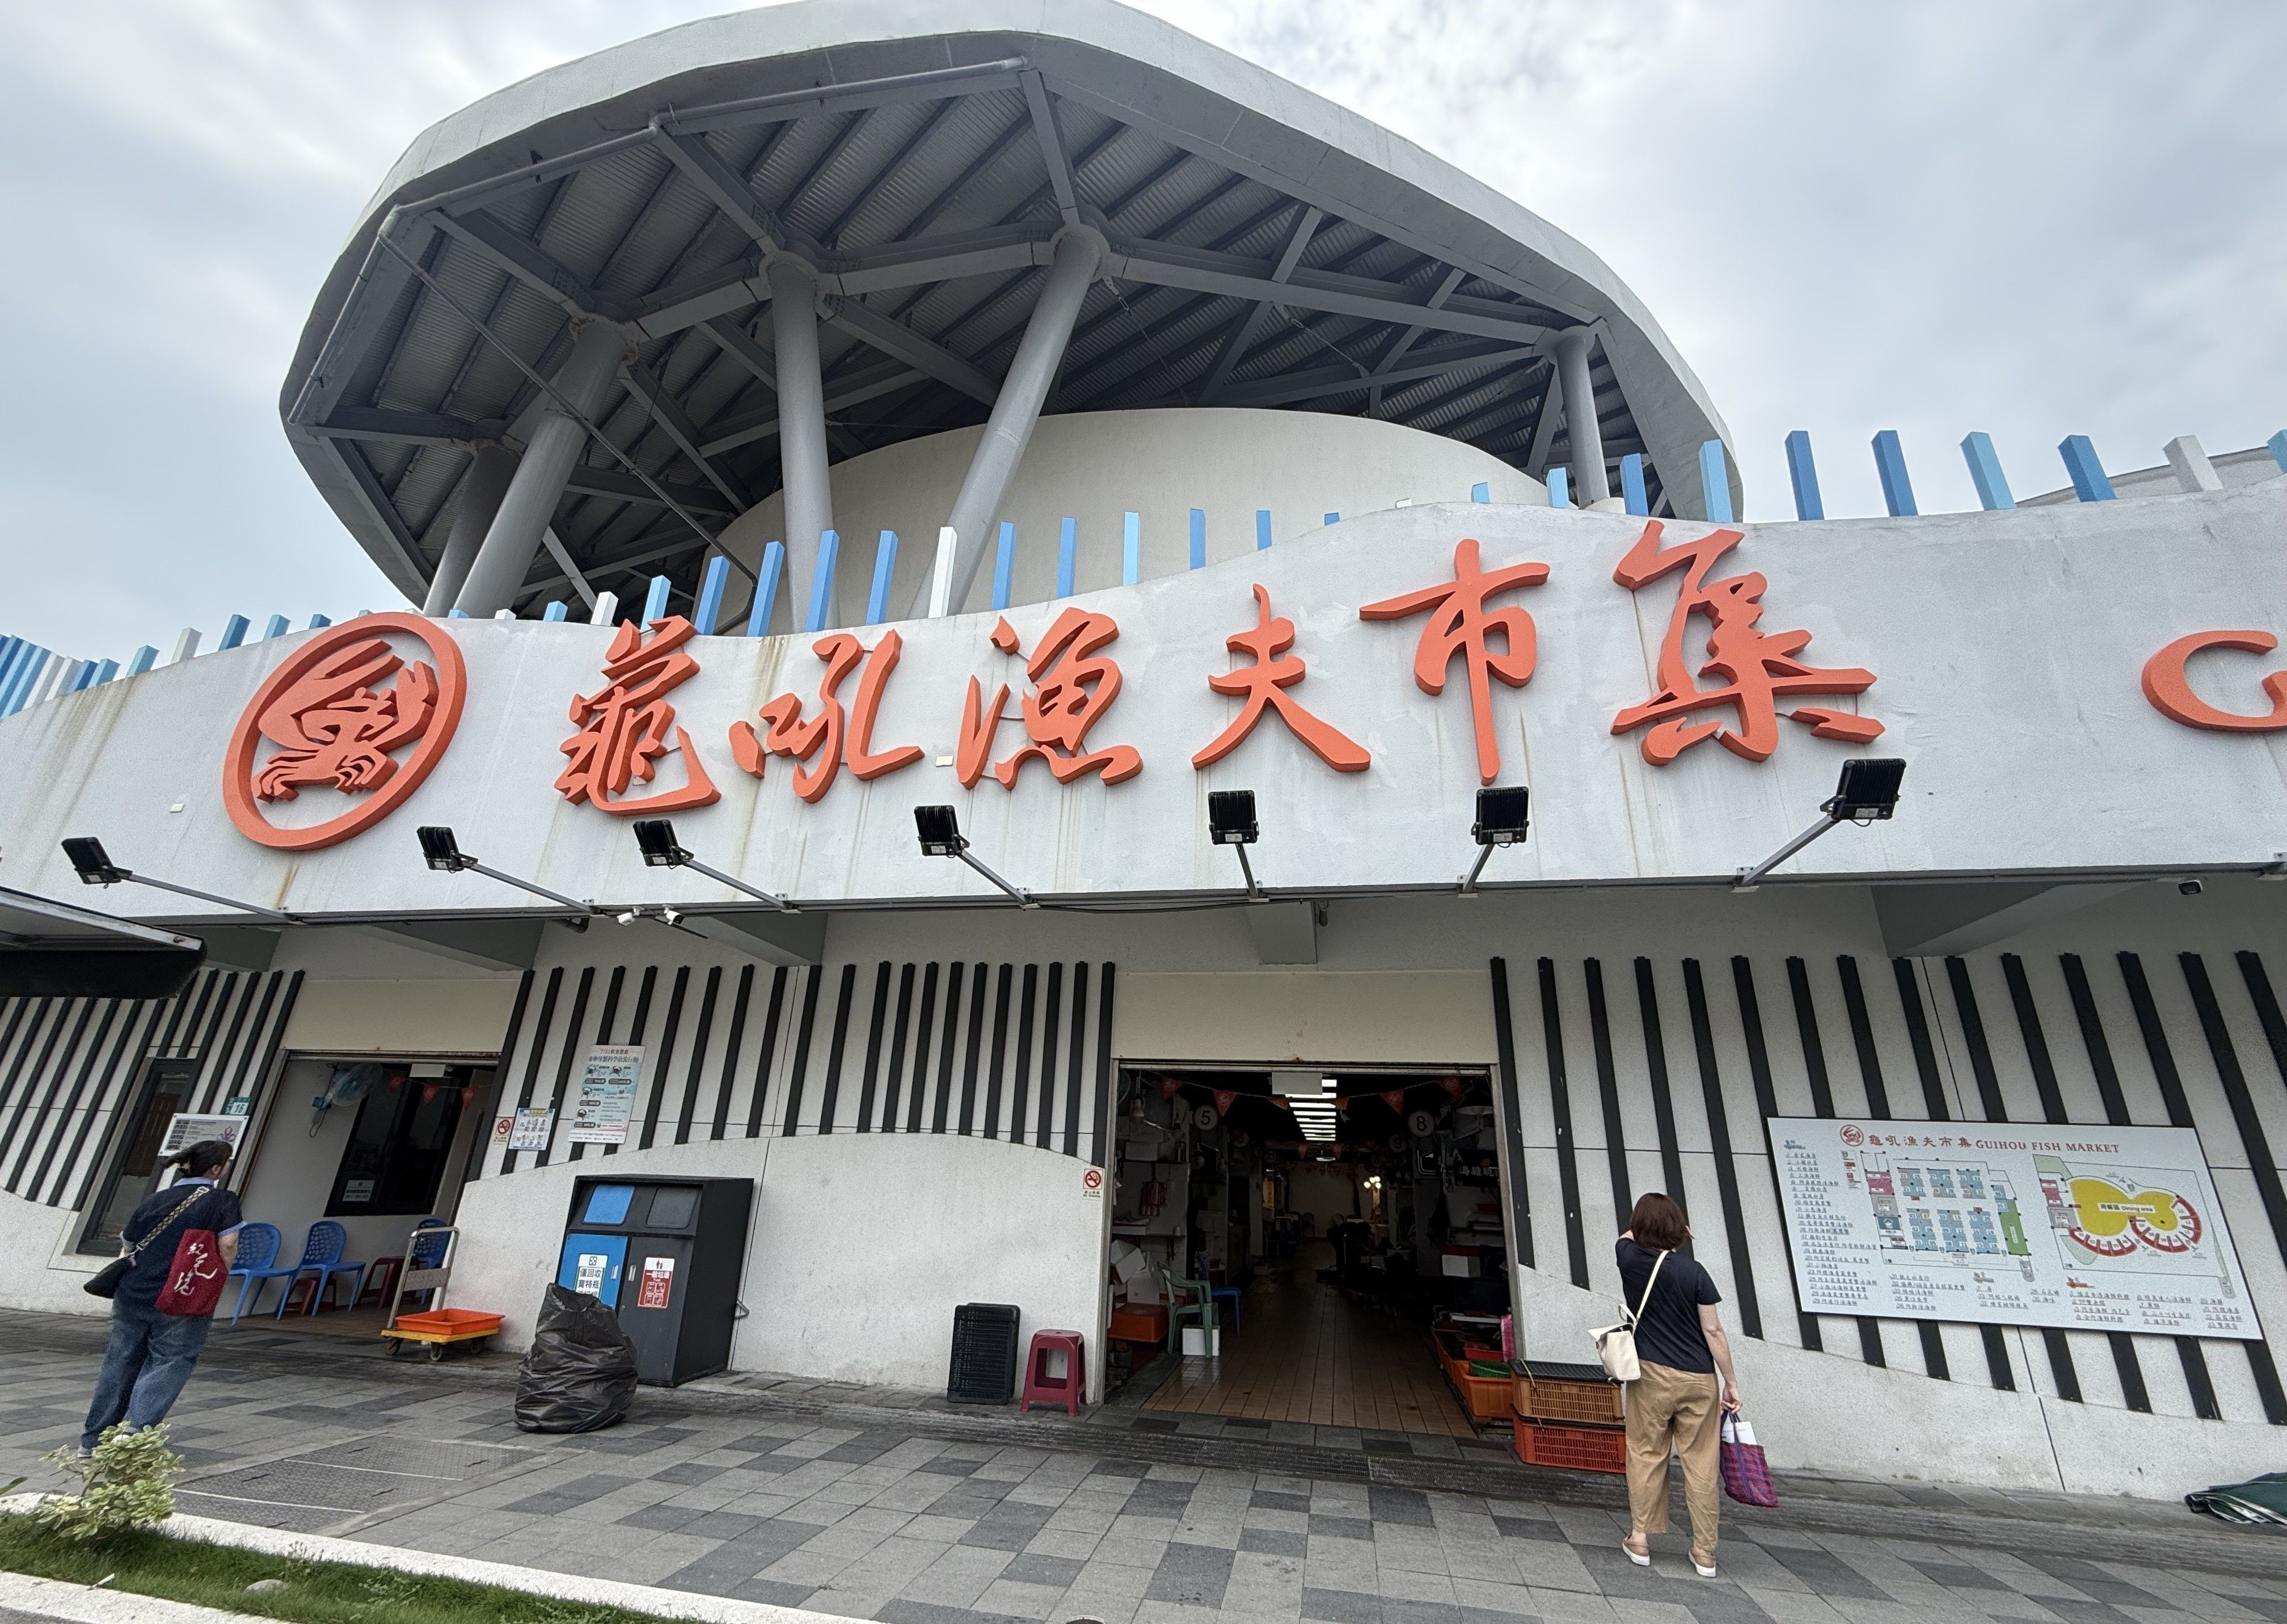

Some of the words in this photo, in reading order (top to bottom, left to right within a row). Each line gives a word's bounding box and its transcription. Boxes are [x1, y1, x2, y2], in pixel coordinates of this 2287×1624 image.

[554, 520, 1885, 817] 龜吼漁夫市集
[1201, 1110, 1211, 1125] 5
[1416, 1116, 1427, 1131] 8
[1868, 1134, 1973, 1148] 龜吼漁夫市集
[1974, 1139, 2027, 1149] GUIHOU
[2031, 1141, 2061, 1150] FISH
[2065, 1142, 2120, 1152] MARKET
[580, 1268, 602, 1278] 僅回收
[577, 1279, 600, 1289] 寶特瓶
